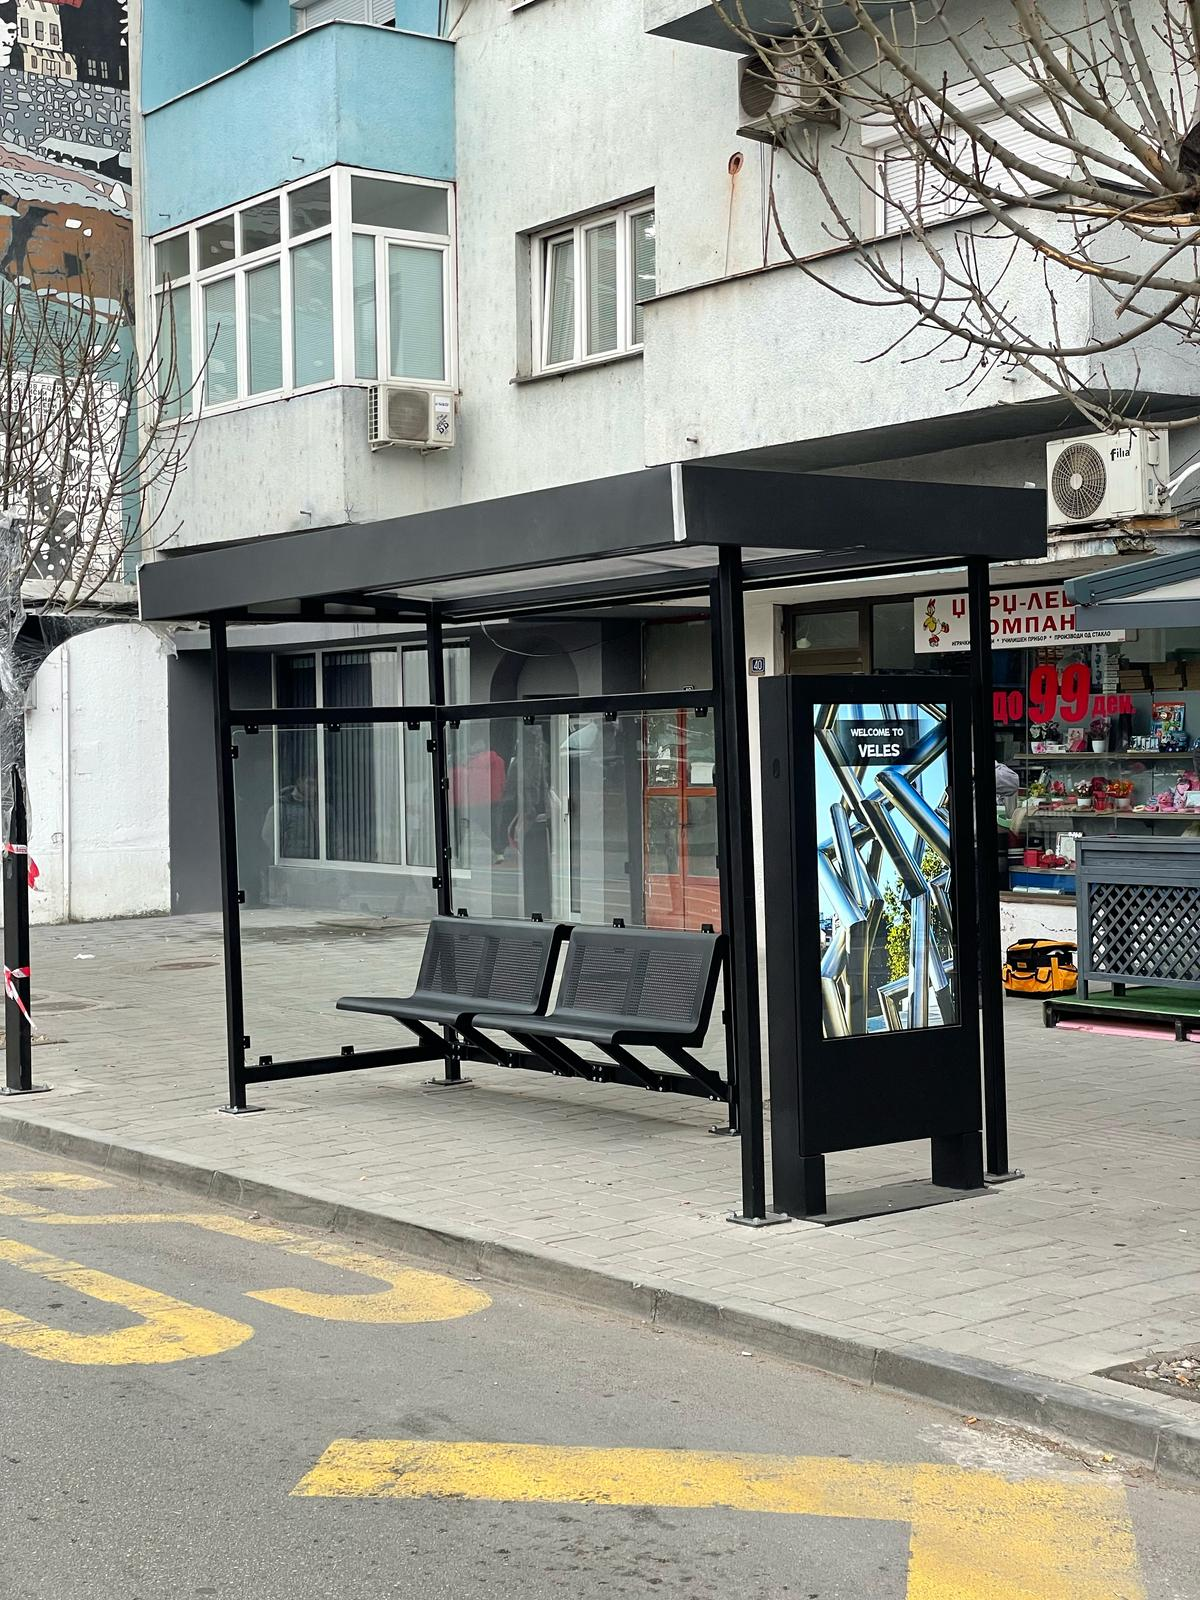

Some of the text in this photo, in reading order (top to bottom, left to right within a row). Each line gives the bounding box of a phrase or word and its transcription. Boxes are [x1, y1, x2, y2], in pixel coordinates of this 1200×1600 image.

[1028, 663, 1091, 724] 99
[850, 727, 904, 737] WELCOME TO
[858, 743, 900, 758] VELES
